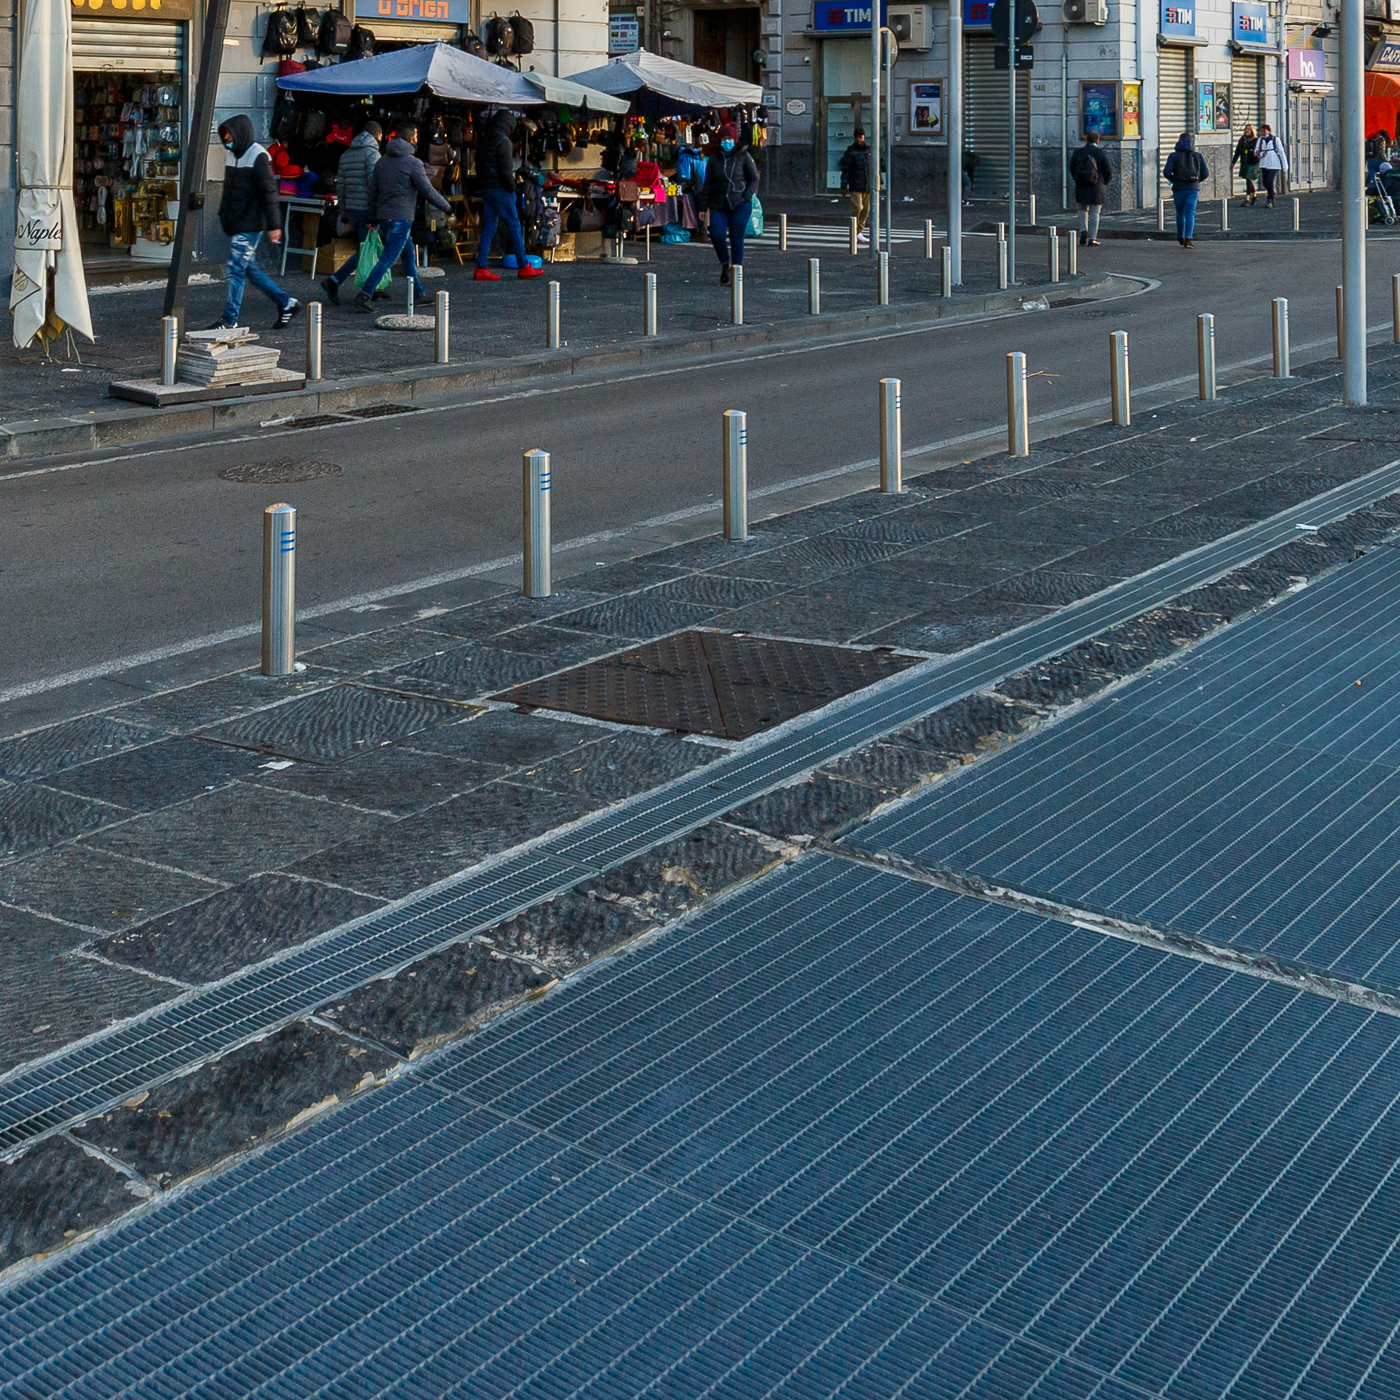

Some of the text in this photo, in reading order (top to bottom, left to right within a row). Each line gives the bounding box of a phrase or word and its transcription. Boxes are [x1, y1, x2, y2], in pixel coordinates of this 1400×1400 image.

[844, 8, 872, 23] TIM
[1176, 8, 1193, 25] TIM
[1249, 16, 1264, 31] TIM
